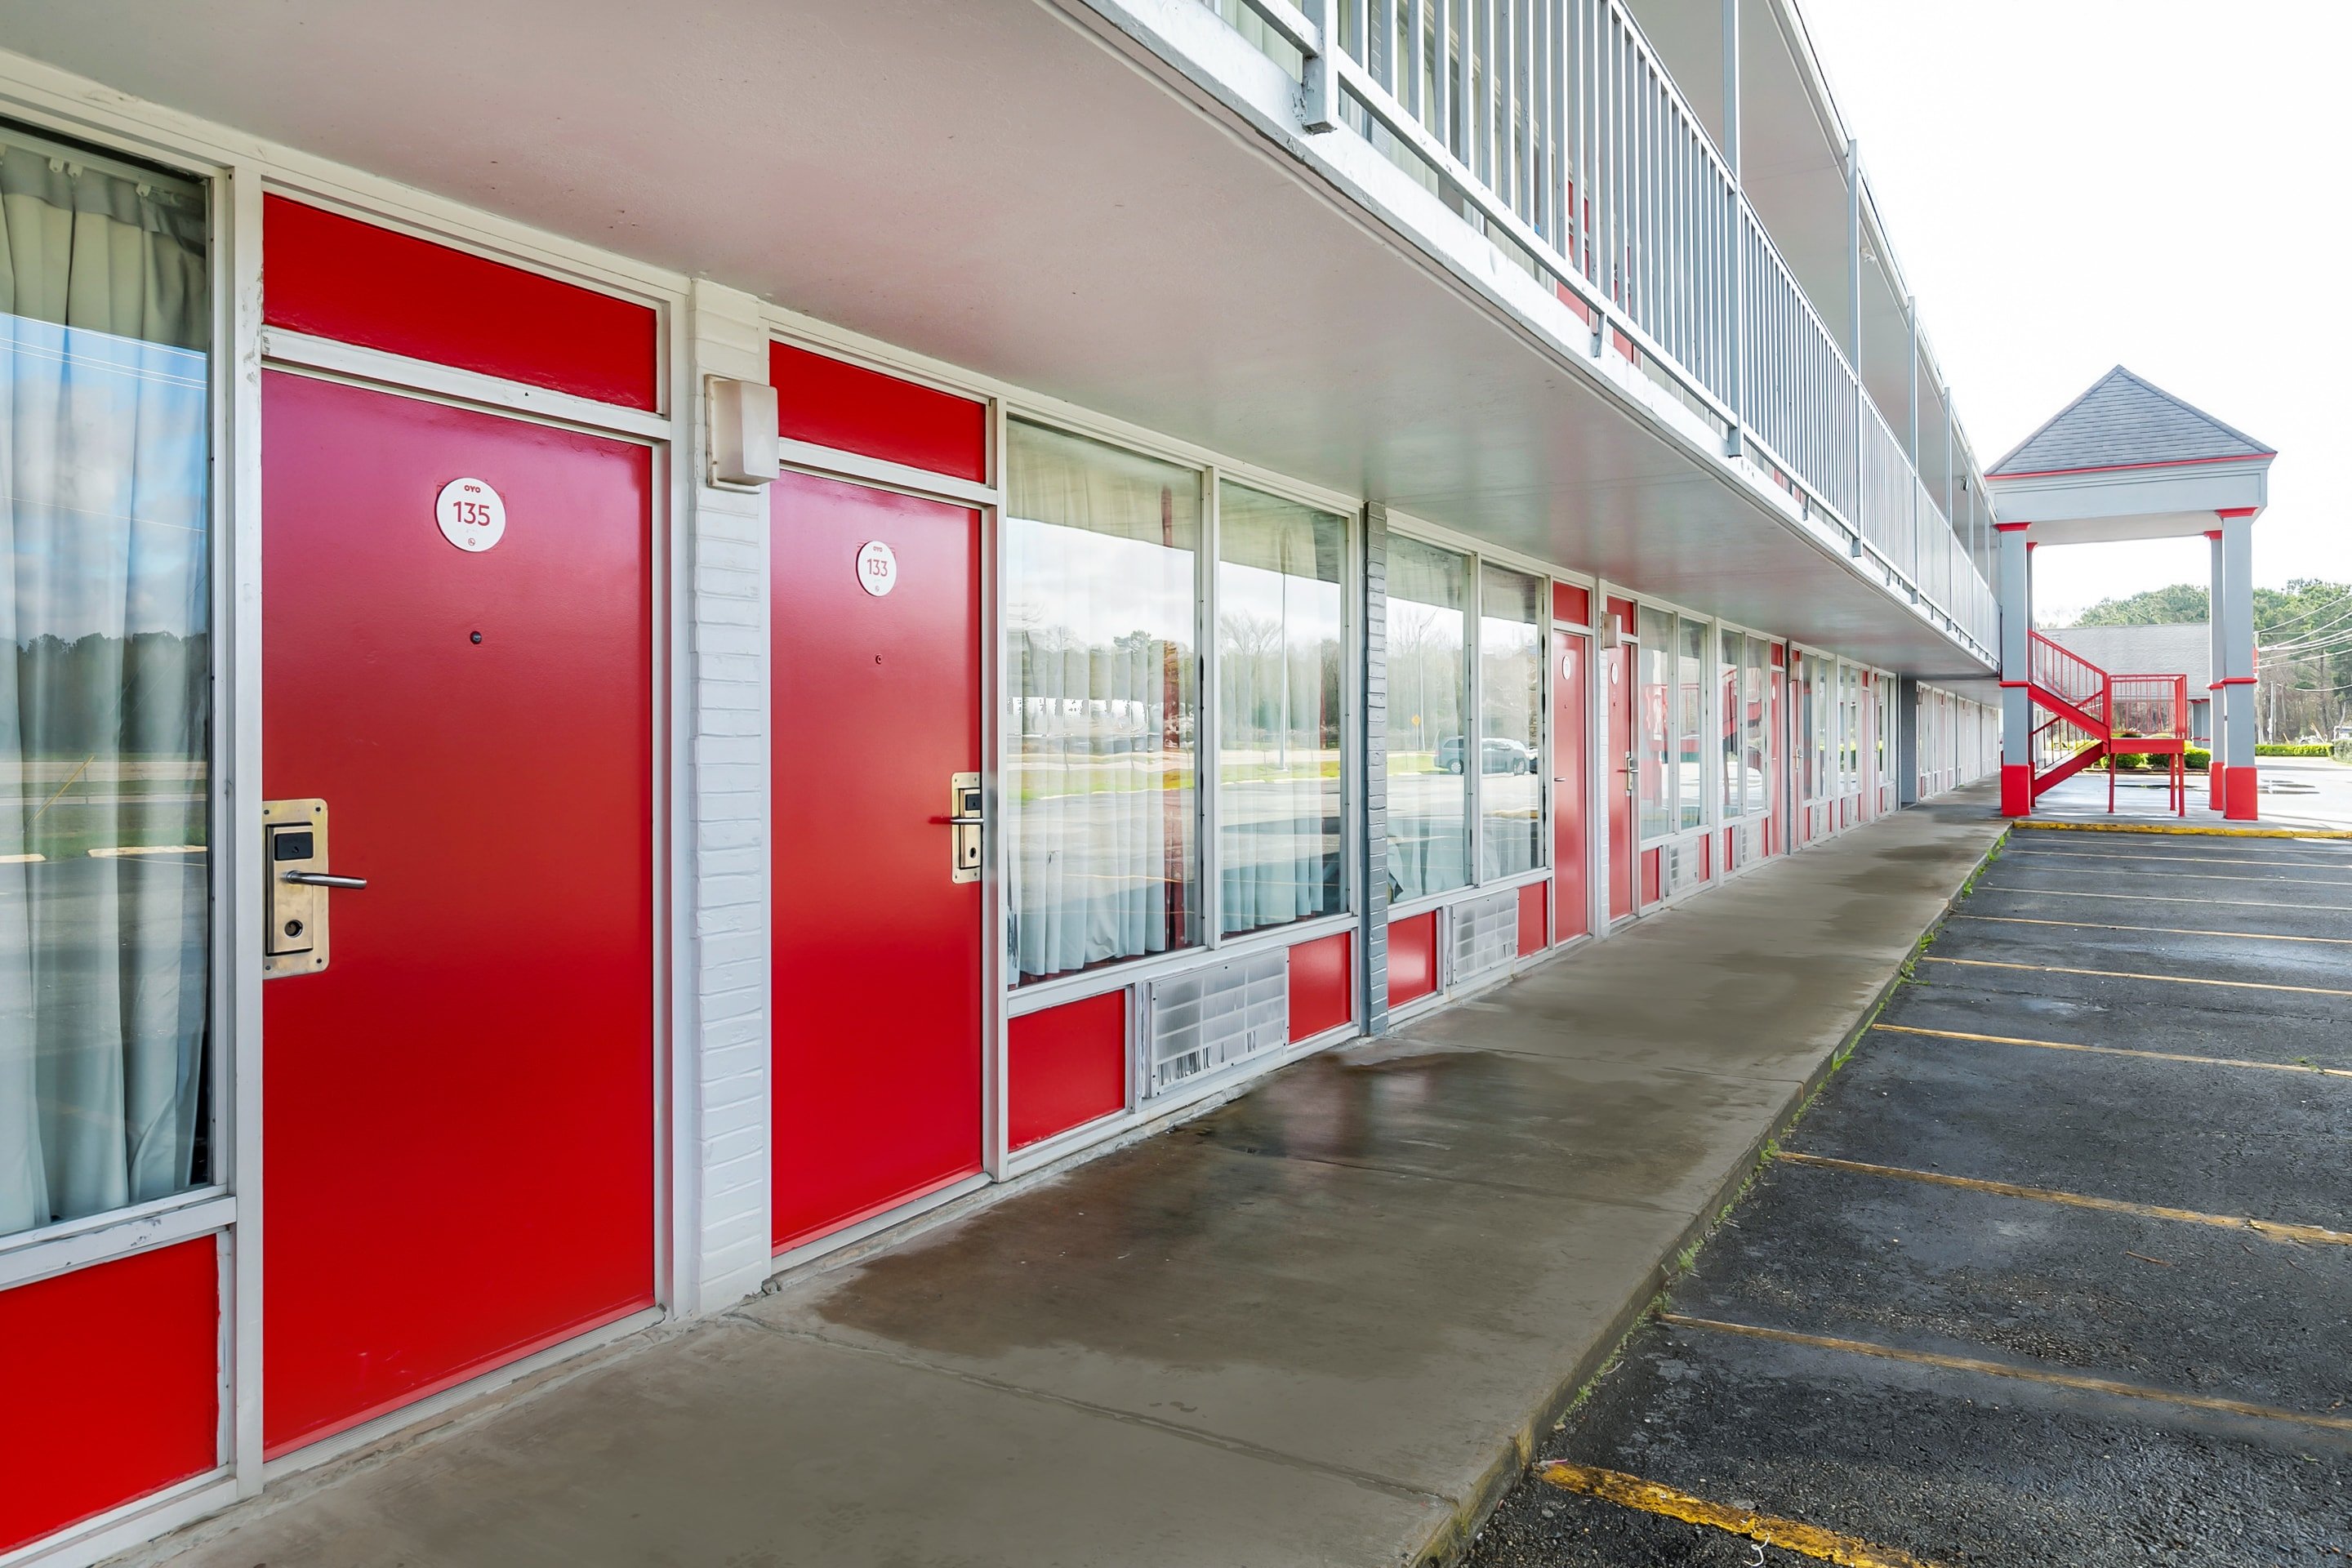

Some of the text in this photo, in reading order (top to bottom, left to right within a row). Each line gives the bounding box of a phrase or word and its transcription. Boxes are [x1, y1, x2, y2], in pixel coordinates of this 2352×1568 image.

[464, 484, 481, 493] OYO
[452, 501, 491, 527] 135
[866, 558, 889, 577] 133
